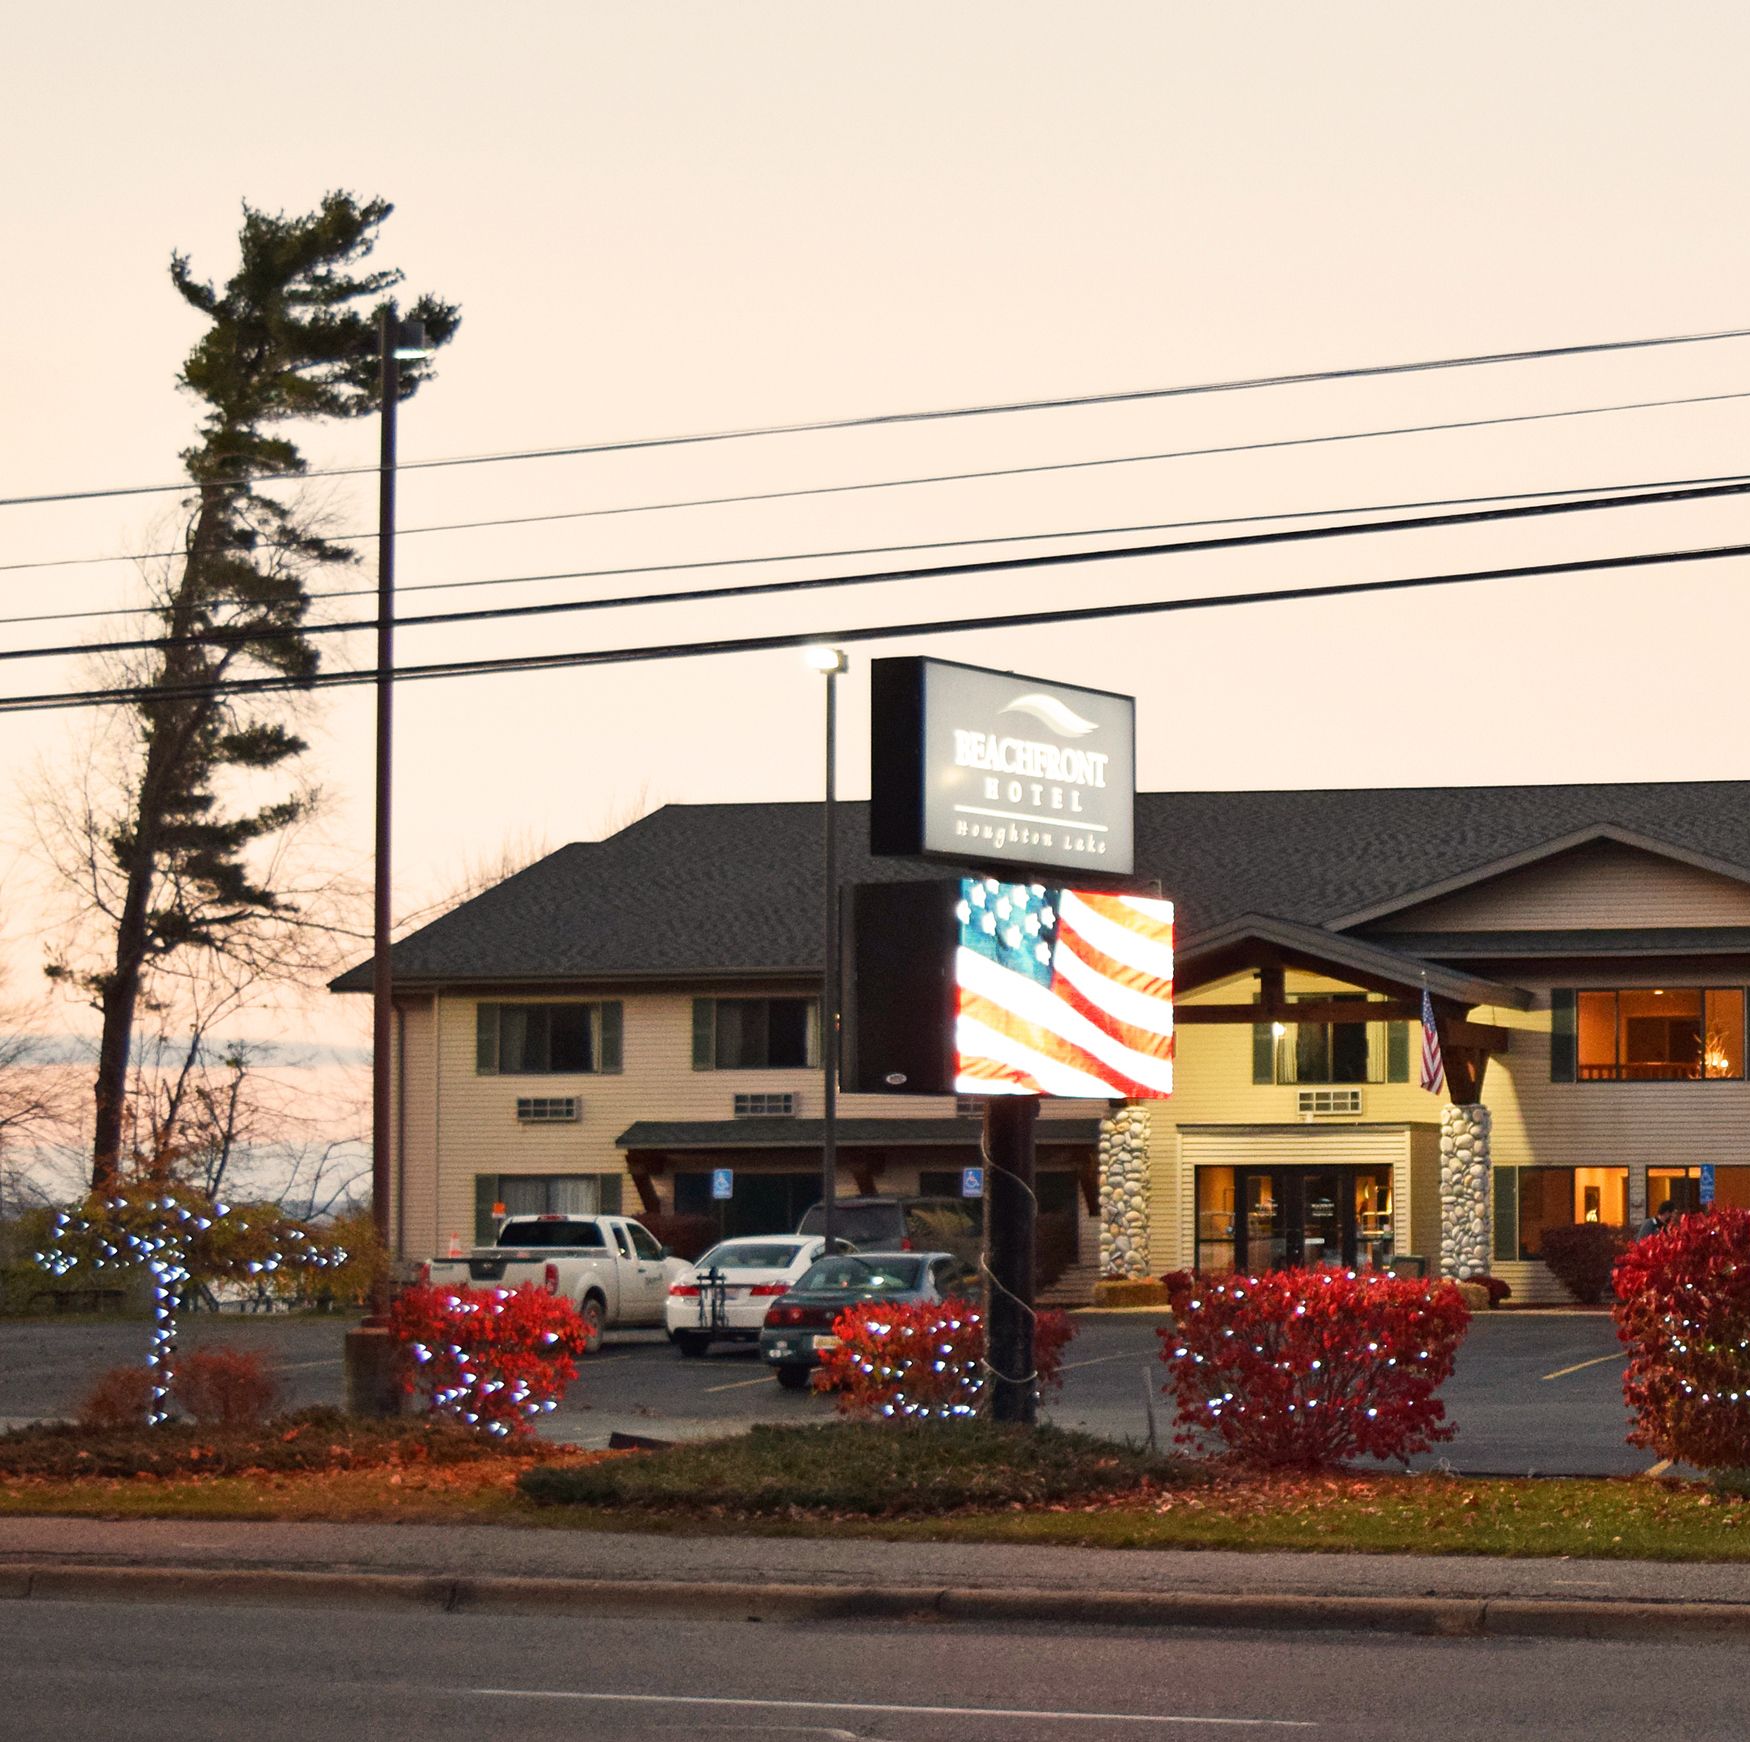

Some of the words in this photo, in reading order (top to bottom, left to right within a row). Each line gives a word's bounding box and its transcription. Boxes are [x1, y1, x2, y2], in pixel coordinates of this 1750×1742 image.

[954, 729, 1108, 788] BEACHFRONT
[984, 776, 1083, 812] HOTEL
[956, 820, 1053, 848] Houghton
[1064, 833, 1106, 854] Lake
